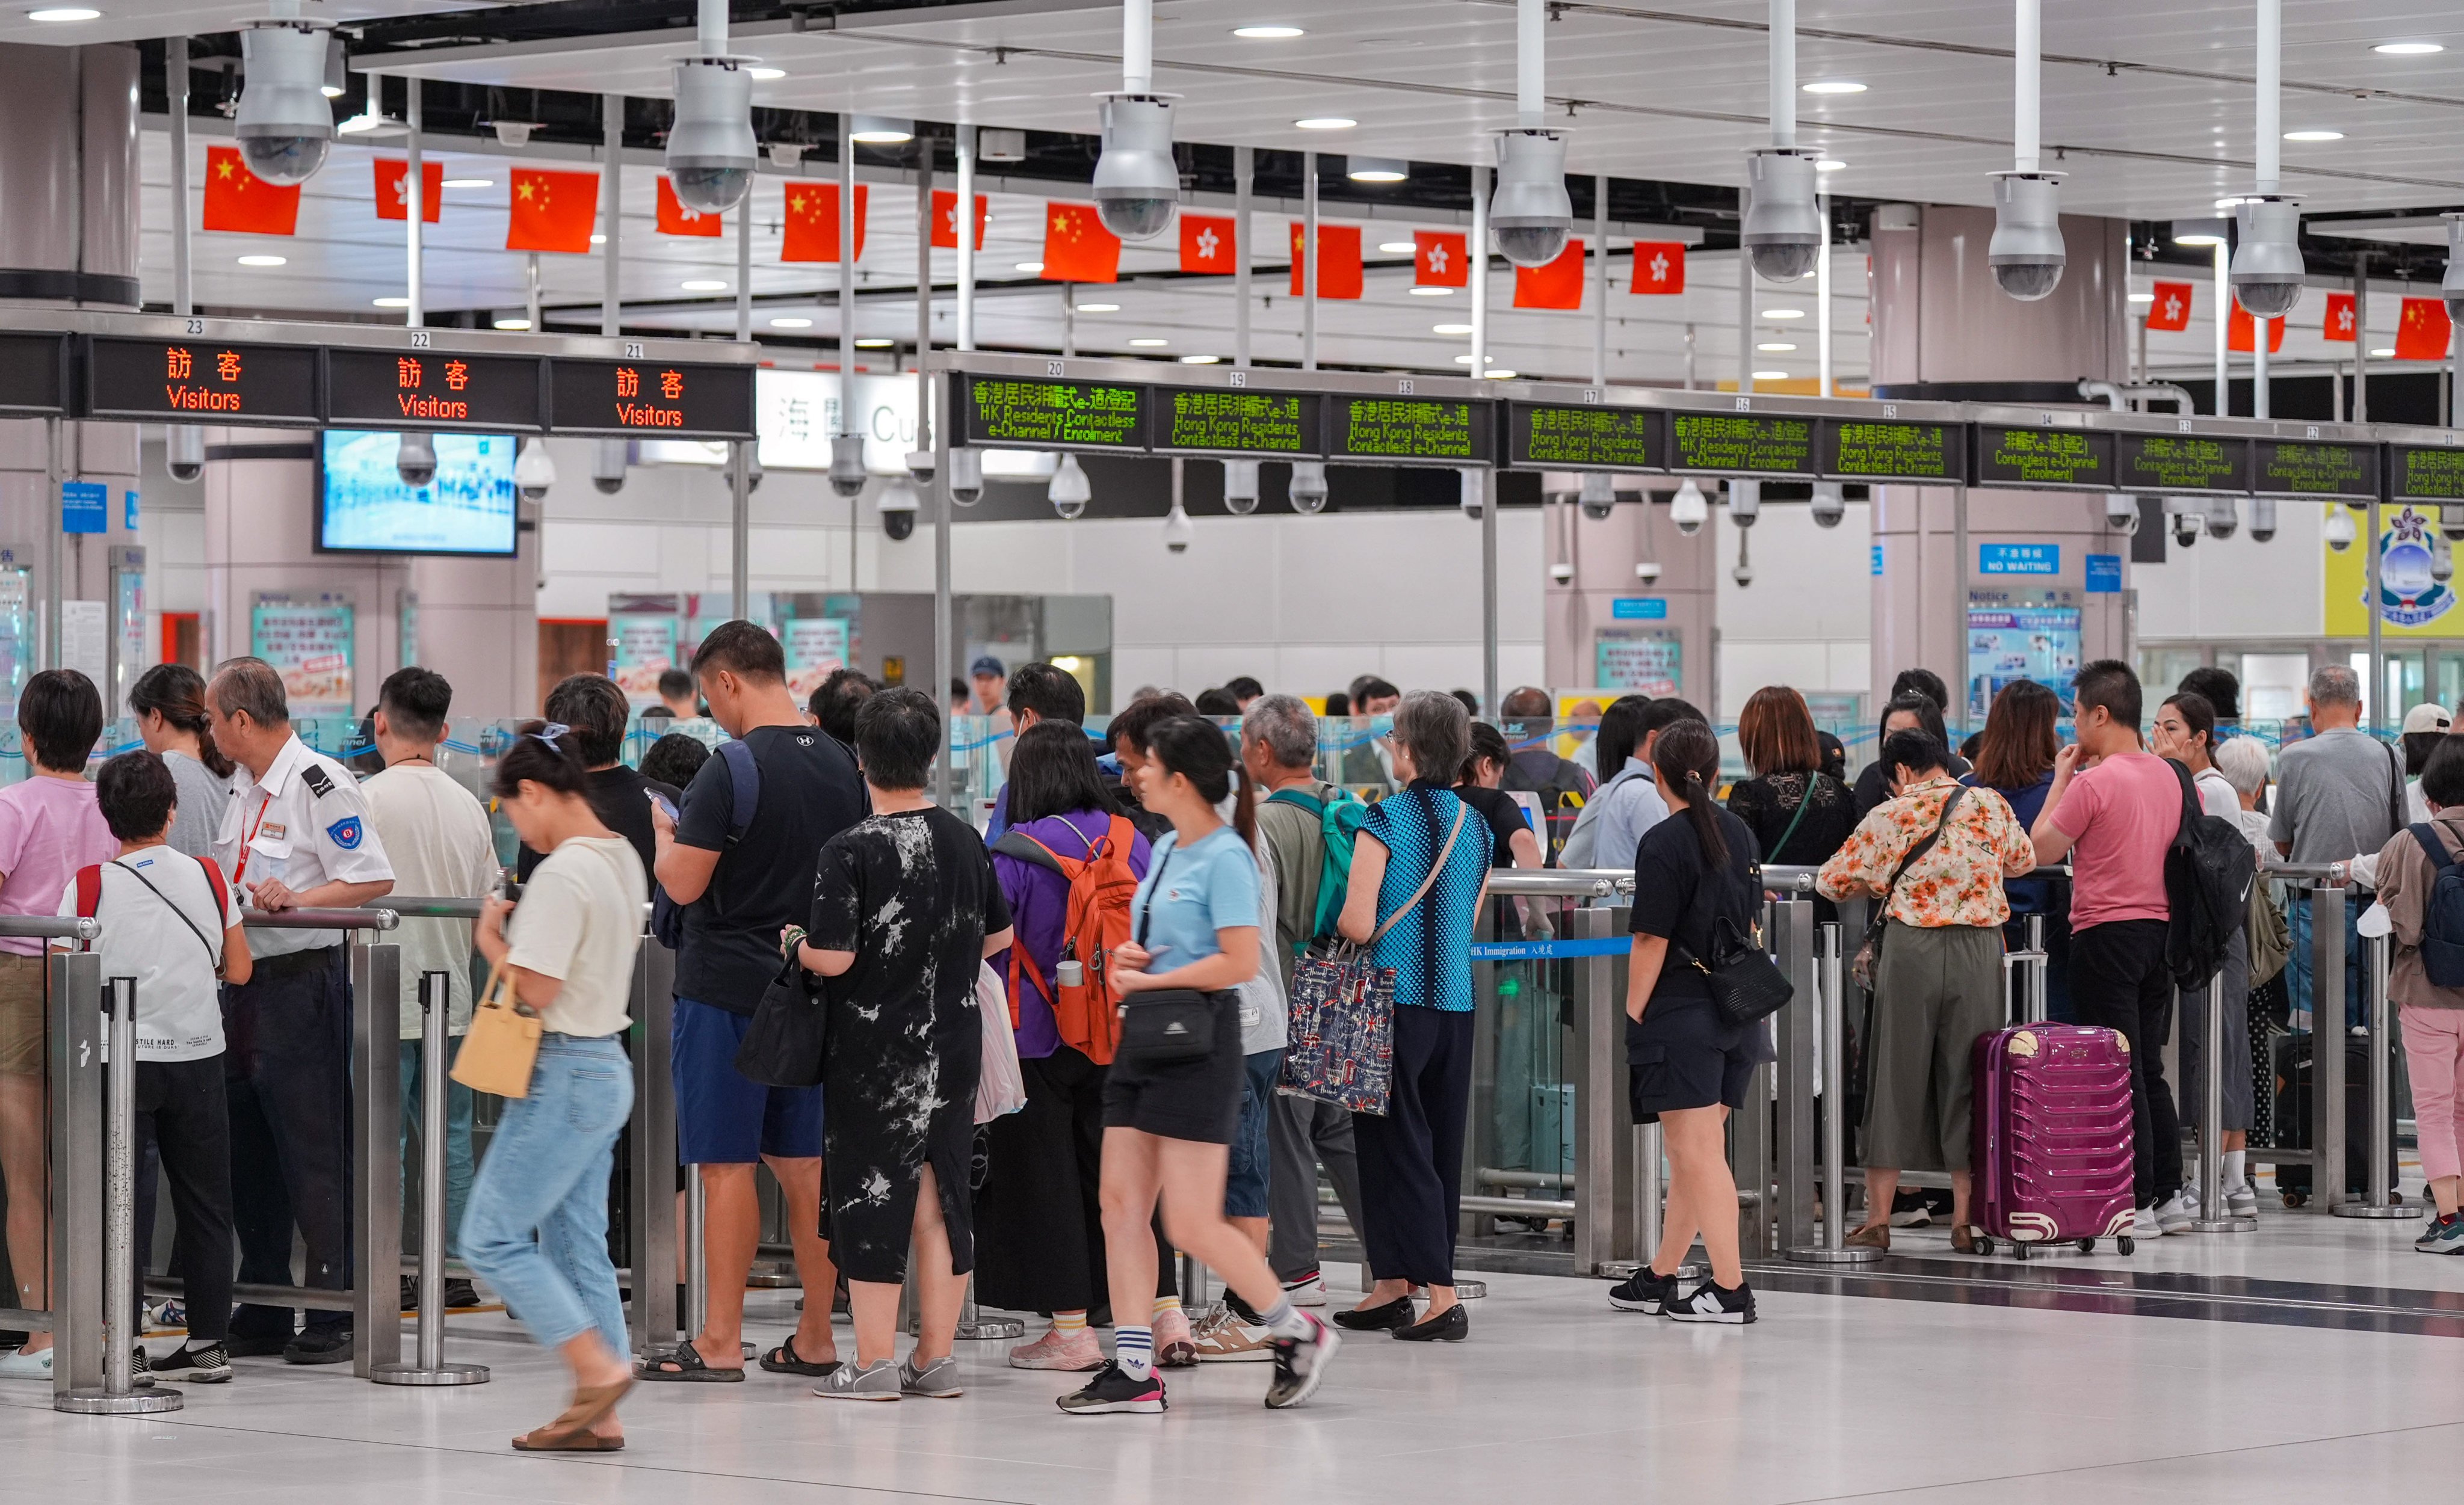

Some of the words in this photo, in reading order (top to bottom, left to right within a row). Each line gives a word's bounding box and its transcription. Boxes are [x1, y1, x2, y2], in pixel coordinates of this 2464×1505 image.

[187, 320, 202, 334] 23
[413, 334, 428, 347] 22
[628, 345, 641, 357] 21
[167, 348, 241, 381] 訪客
[1049, 363, 1062, 375] 20
[398, 357, 469, 390] 訪客
[1232, 375, 1243, 386] 19
[617, 368, 682, 399] 訪客
[1401, 381, 1412, 393] 18
[167, 384, 240, 410] Visitors
[1586, 392, 1596, 402] 17
[1738, 398, 1749, 410] 16
[398, 394, 467, 418] Visitors
[617, 403, 682, 426] Visitors
[1885, 406, 1894, 418] 15
[980, 404, 1001, 421] HK
[1004, 405, 1064, 425] Residents
[1066, 408, 1135, 428] Contactless
[1175, 414, 1206, 435] Hong
[1208, 415, 1240, 435] Kong
[1241, 417, 1298, 435] Residents
[2043, 414, 2051, 425] 14
[988, 420, 1051, 439] e-Channel
[1350, 421, 1380, 441] Hong
[1383, 423, 1412, 443] Kong
[1414, 424, 1469, 441] Residents
[2181, 422, 2190, 432] 13
[2309, 428, 2317, 438] 12
[1172, 429, 1239, 448] Contactless
[1241, 432, 1301, 450] e-Channel
[1348, 435, 1411, 454] Contactless
[1414, 439, 1471, 456] e-Channel
[1531, 429, 1560, 449] Hong
[1563, 431, 1590, 451] Kong
[1592, 432, 1643, 449] Residents
[1680, 437, 1697, 452] HK
[1699, 438, 1749, 454] Residents
[1751, 440, 1808, 457] Contactless
[2445, 434, 2453, 445] 11
[1529, 443, 1589, 461] Contactless
[1592, 446, 1645, 463] e-Channel
[1687, 452, 1739, 468] e-Channel
[1840, 443, 1866, 463] Hong
[1868, 445, 1894, 463] Kong
[1895, 446, 1942, 461] Residents
[1995, 450, 2048, 467] Contactless
[2051, 452, 2098, 469] e-Channel
[1838, 457, 1893, 473] Contactless
[1896, 458, 1944, 475] e-Channel
[2407, 469, 2430, 486] Hong
[2431, 470, 2453, 486] Kong
[1988, 561, 2003, 571] NO
[2007, 561, 2052, 572] WAITING
[1969, 591, 2009, 600] Notice
[1471, 946, 1482, 956] HK
[1484, 946, 1526, 957] Immigration
[1531, 944, 1553, 955] 入境處
